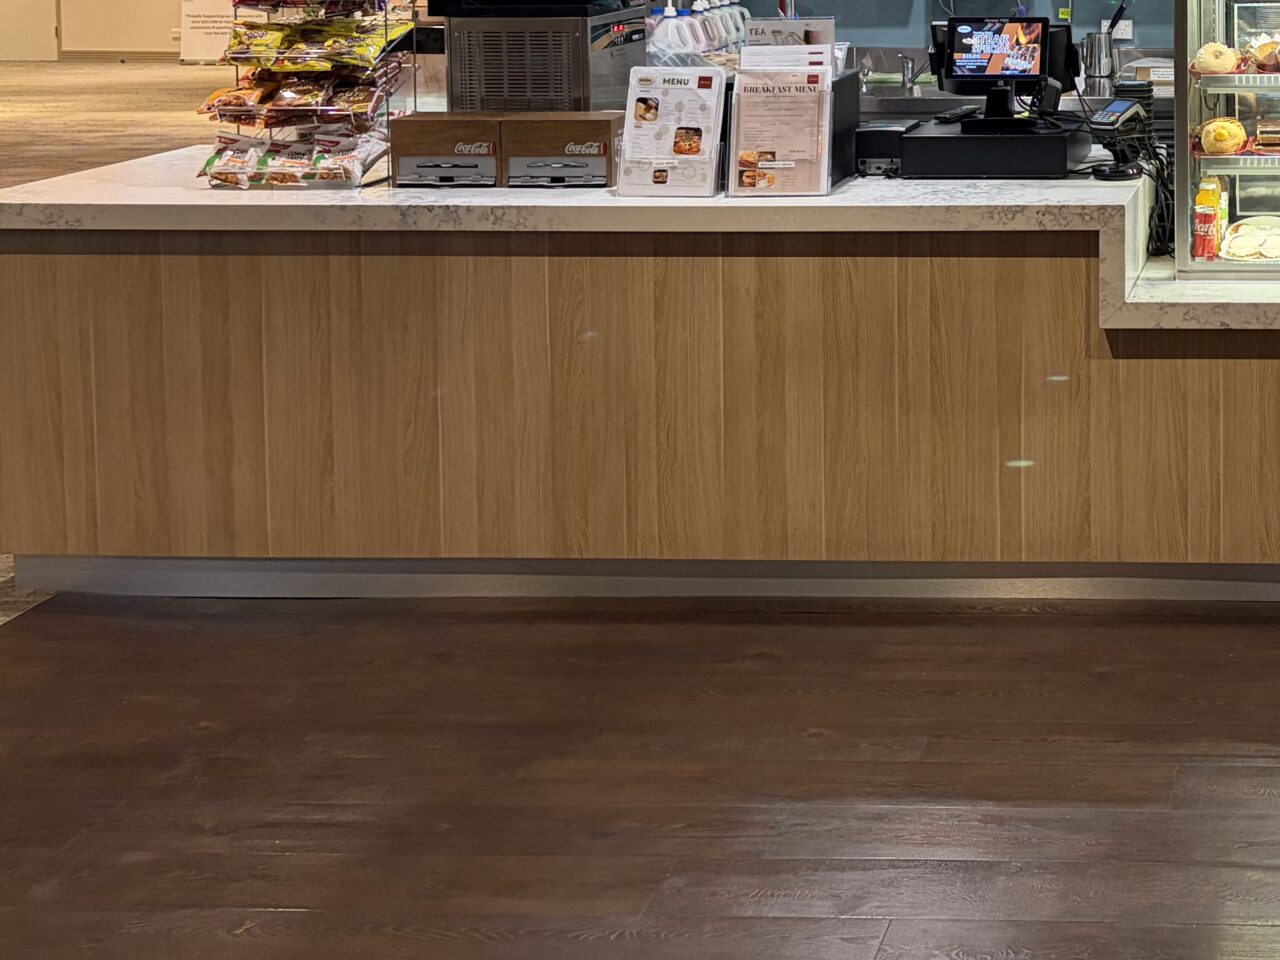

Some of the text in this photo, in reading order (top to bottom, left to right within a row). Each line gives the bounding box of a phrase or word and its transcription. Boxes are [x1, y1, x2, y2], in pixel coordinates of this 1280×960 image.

[749, 28, 766, 37] TEA
[972, 34, 1010, 45] STEAK
[971, 44, 1011, 54] SPECIAL
[662, 78, 689, 86] MENU
[744, 84, 817, 94] BREAKFAST MENU
[455, 142, 488, 155] Coca-Cola
[565, 142, 599, 155] Coca-Cola
